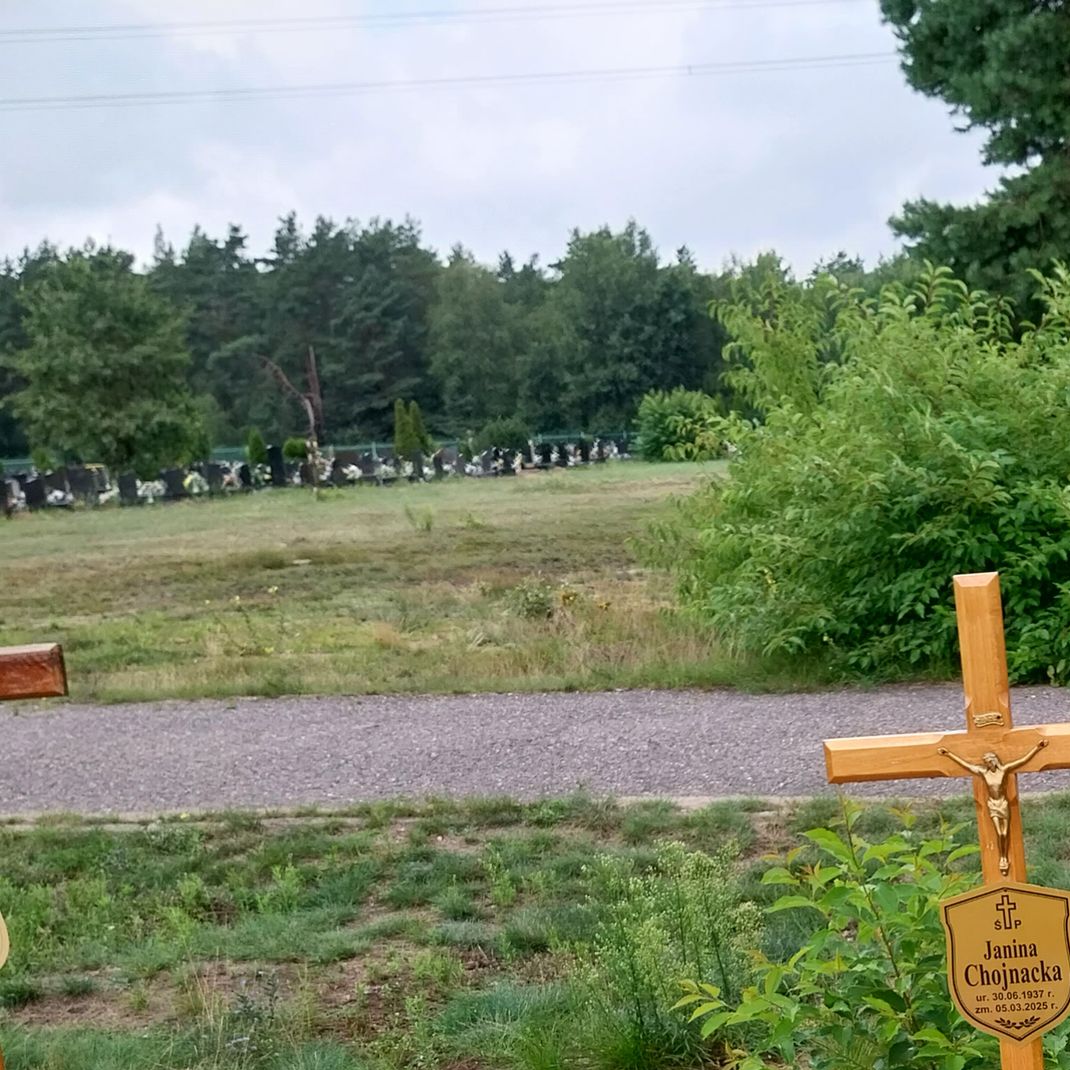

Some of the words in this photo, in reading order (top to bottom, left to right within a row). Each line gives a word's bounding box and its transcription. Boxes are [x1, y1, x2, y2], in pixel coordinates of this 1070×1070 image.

[1014, 920, 1022, 929] P
[983, 939, 1038, 960] Janina
[964, 960, 1063, 991] Chojnacka
[976, 994, 989, 1002] ur.
[992, 989, 1044, 1001] 30.06.1937
[975, 1006, 993, 1014] zm.
[995, 1001, 1048, 1013] 05.03.2025
